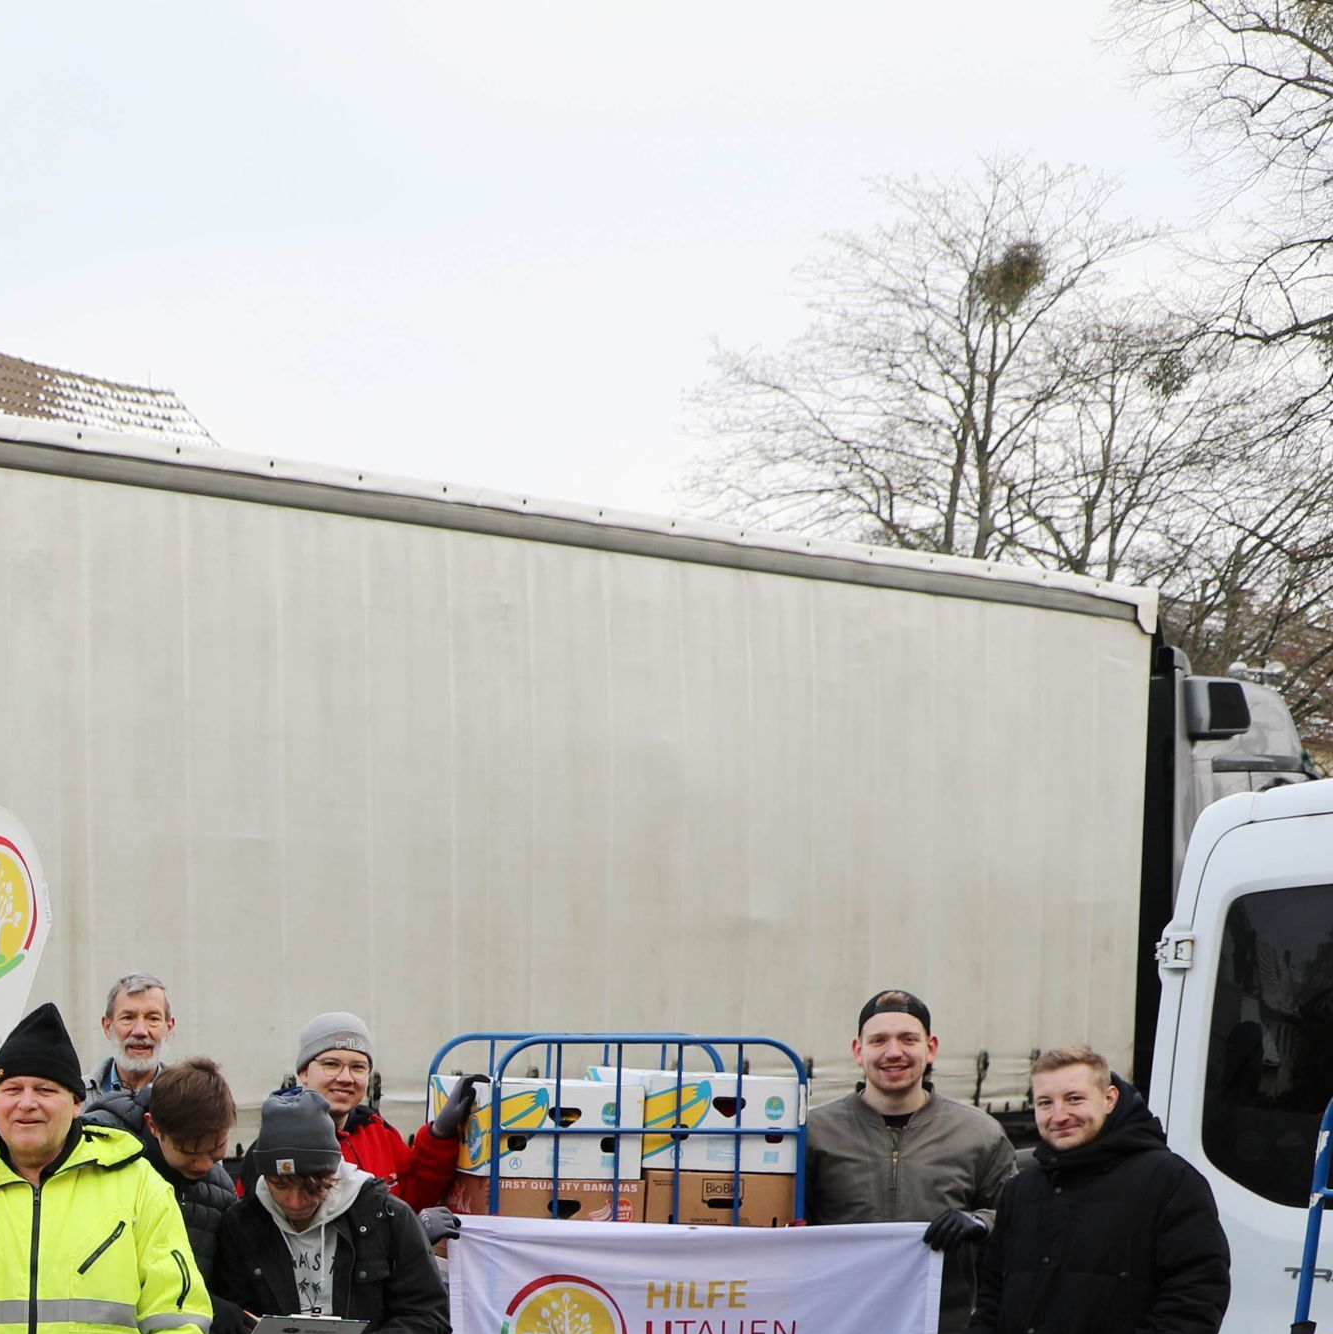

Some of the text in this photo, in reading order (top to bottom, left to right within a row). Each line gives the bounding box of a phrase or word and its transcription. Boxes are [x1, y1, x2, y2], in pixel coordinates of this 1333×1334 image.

[336, 1037, 366, 1051] FILA
[498, 1180, 527, 1190] IRST
[646, 1280, 748, 1309] HILFE
